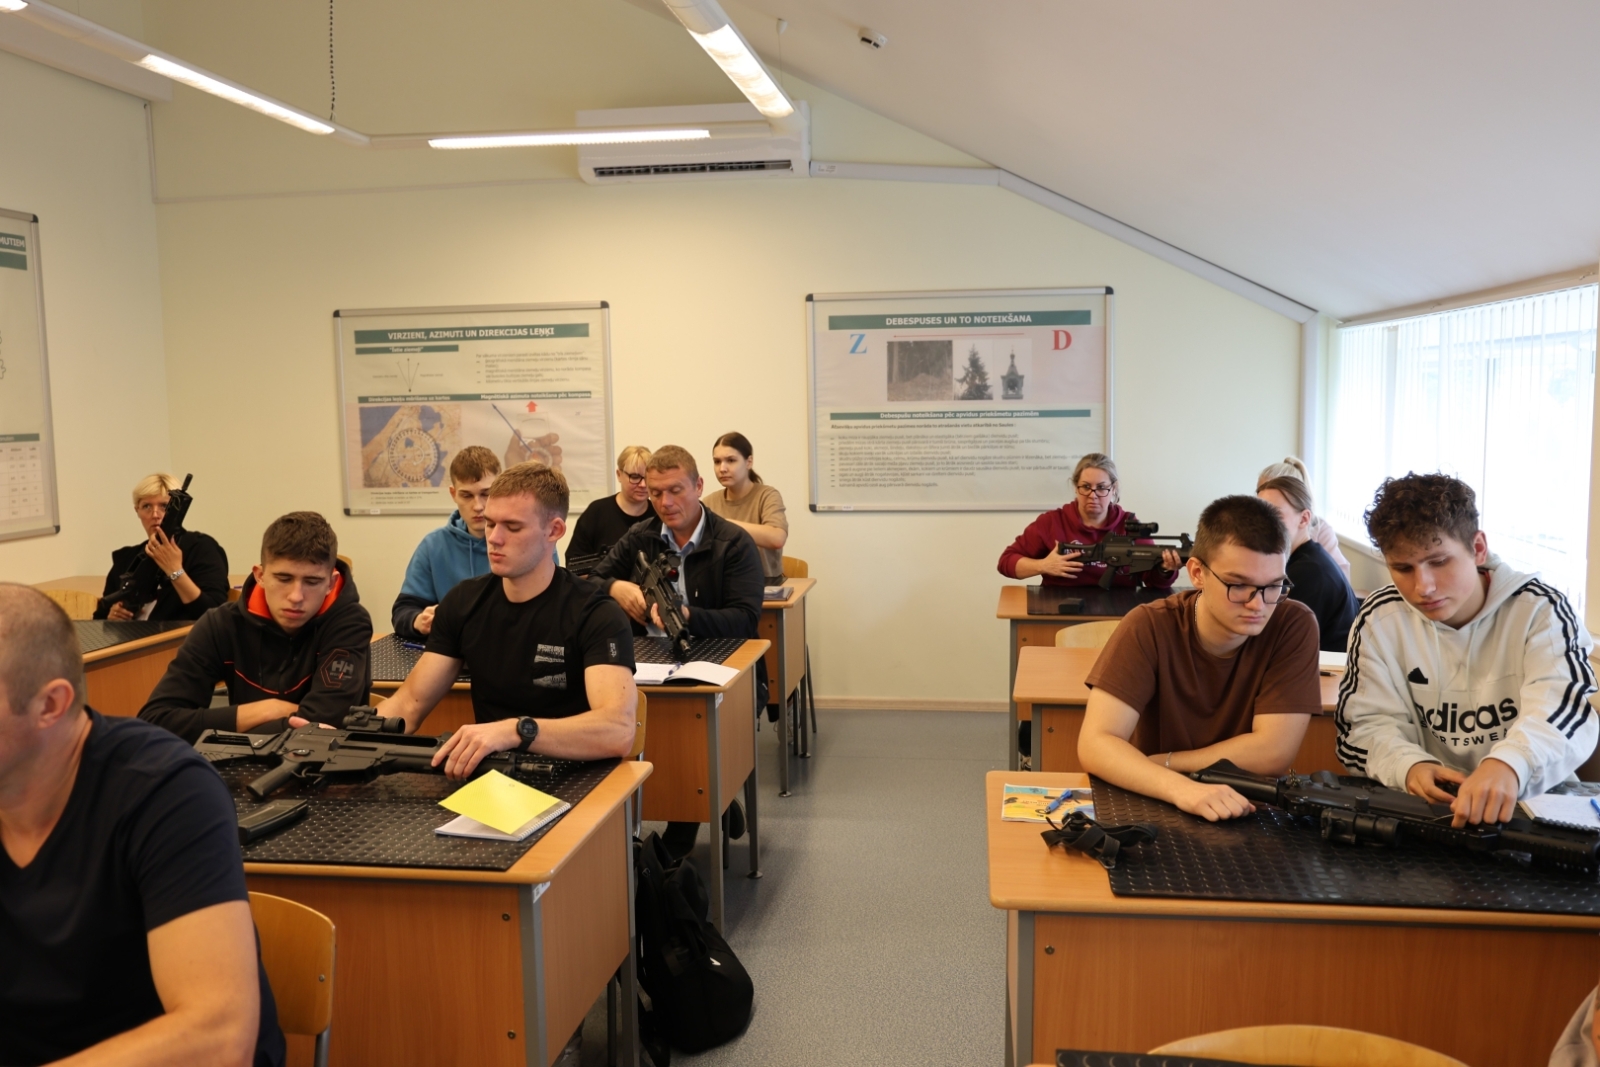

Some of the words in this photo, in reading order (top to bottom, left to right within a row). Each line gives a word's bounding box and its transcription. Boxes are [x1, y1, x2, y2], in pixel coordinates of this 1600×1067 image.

[886, 316, 942, 326] DEBESPUSES
[944, 316, 957, 325] UN
[960, 315, 972, 324] TO
[974, 313, 1032, 324] NOTEIKŠANA
[388, 331, 427, 340] VIRZIENI,
[429, 330, 464, 339] AZIMUTI
[465, 329, 477, 337] UN
[479, 328, 528, 337] DIREKCIJAS
[529, 327, 555, 337] LEŅĶI
[1052, 329, 1072, 351] D
[849, 333, 867, 354] Z
[880, 412, 911, 420] Debespušu
